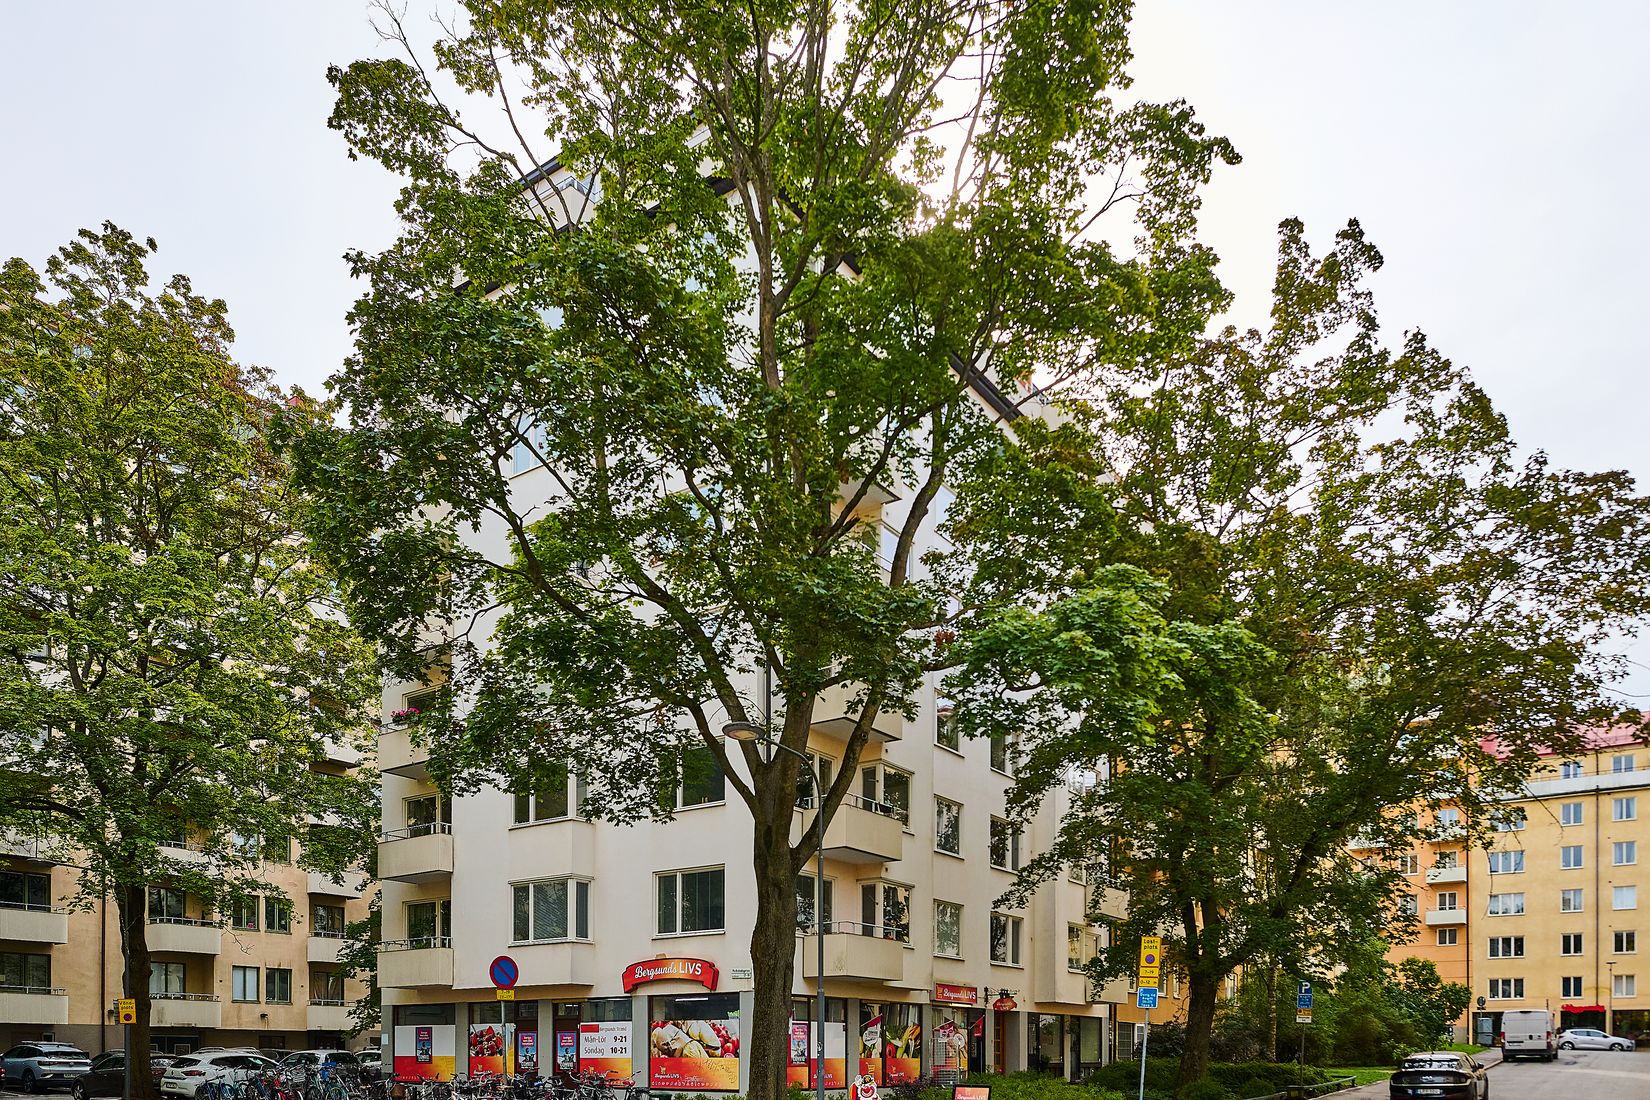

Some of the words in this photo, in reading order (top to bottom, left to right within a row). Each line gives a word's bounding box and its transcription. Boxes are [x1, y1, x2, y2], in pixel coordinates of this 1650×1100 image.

[634, 962, 677, 979] Bergsunds
[679, 962, 702, 975] LIVS
[1302, 982, 1311, 993] P
[964, 989, 976, 999] LIVS
[613, 1035, 627, 1043] 9-21
[584, 1046, 605, 1056] Söndag
[610, 1046, 627, 1054] 10-21
